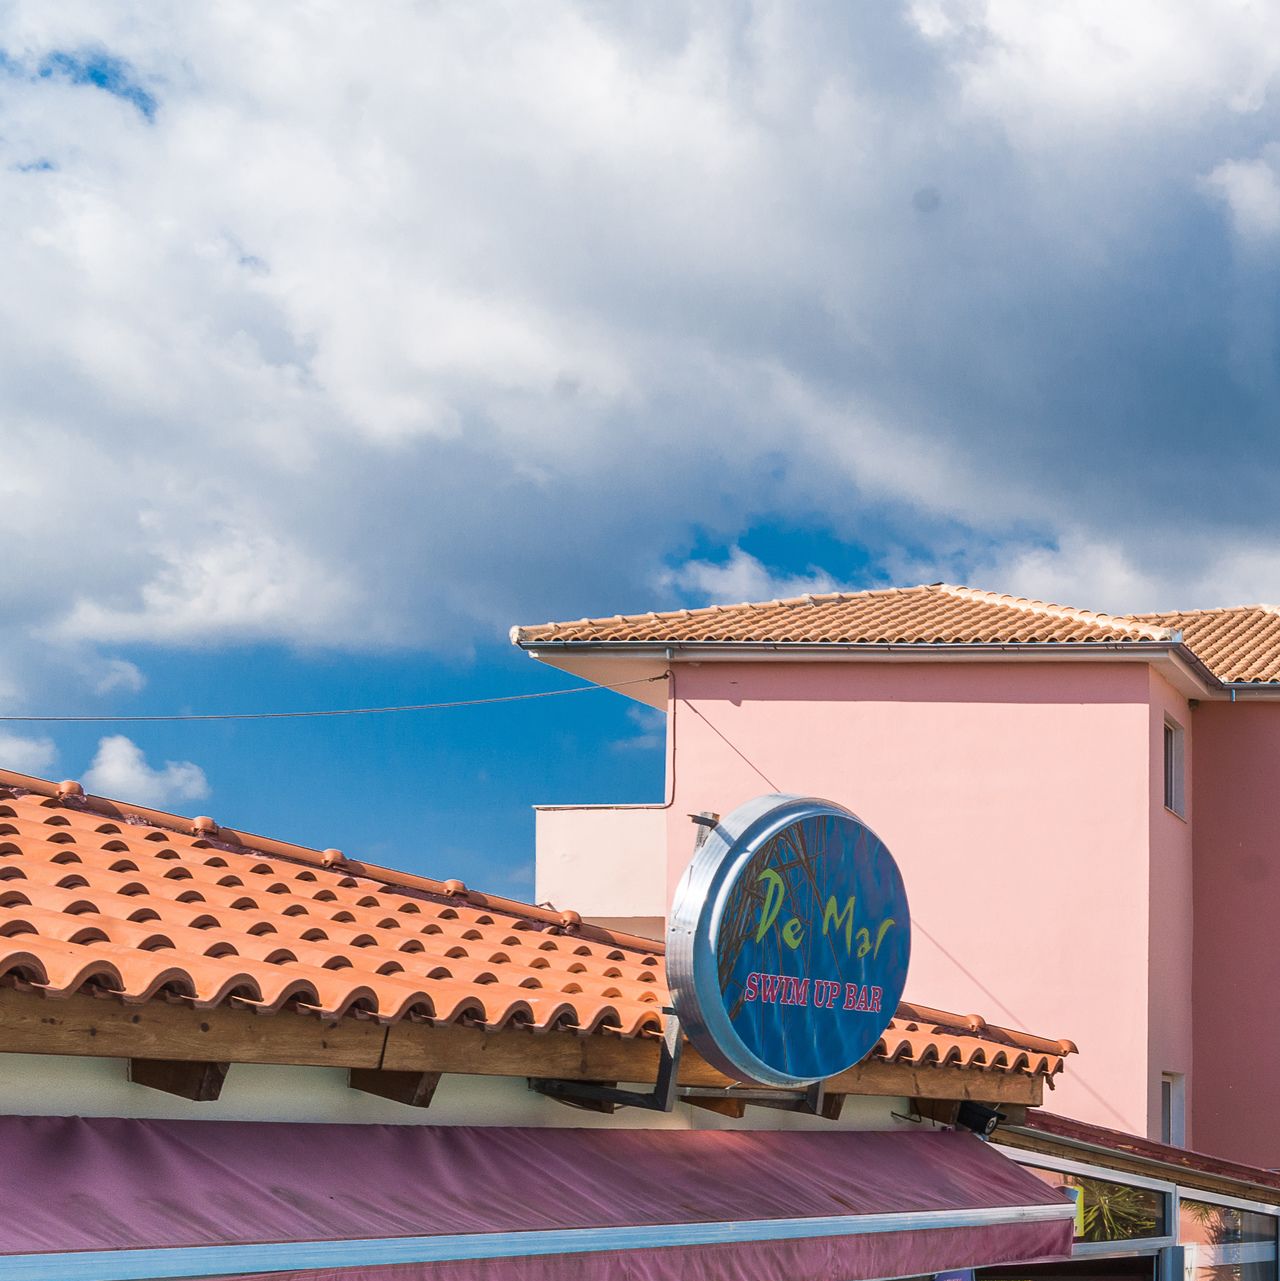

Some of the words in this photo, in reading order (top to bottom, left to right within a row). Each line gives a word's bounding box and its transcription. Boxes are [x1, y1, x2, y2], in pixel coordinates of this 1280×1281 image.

[756, 868, 805, 949] De
[822, 895, 896, 960] Mar
[744, 971, 808, 1007] SWIM
[814, 980, 840, 1009] UP
[842, 982, 883, 1013] BAR
